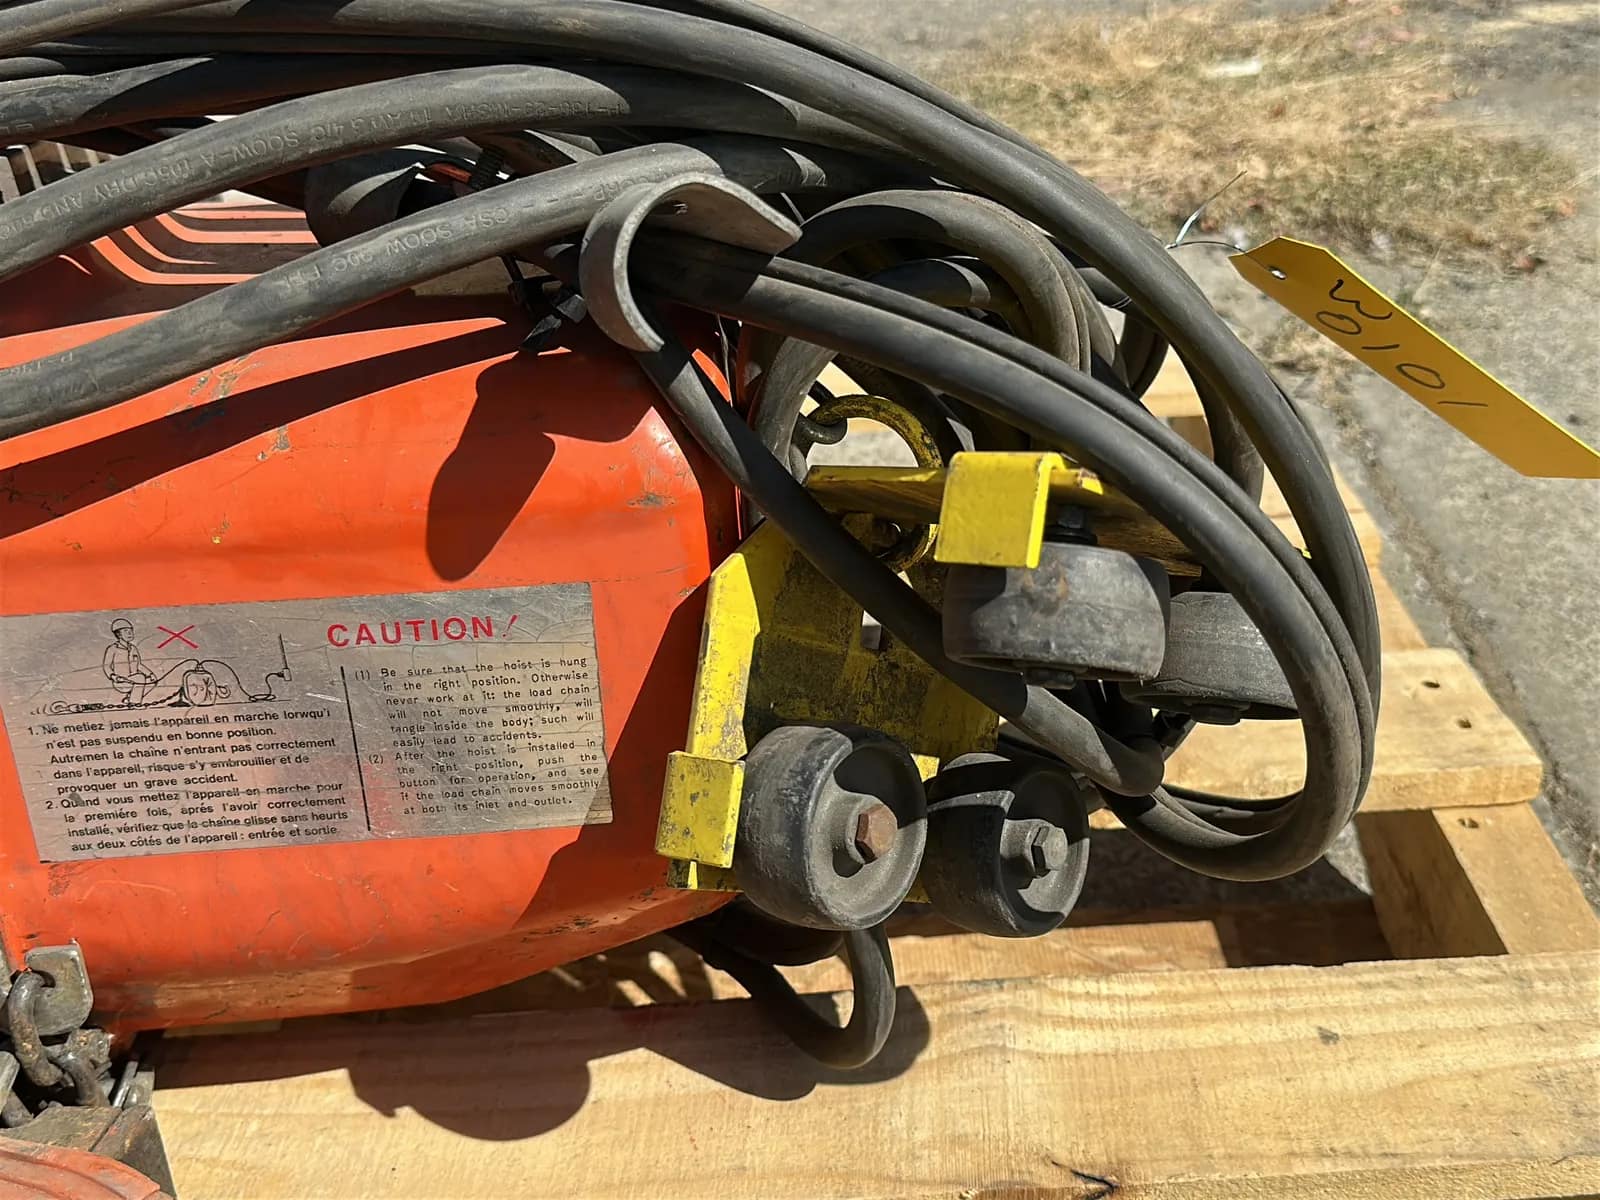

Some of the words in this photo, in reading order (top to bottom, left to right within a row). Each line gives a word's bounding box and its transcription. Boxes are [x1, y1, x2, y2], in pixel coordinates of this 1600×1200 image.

[381, 218, 455, 258] SOOW
[355, 670, 370, 680] (1)
[381, 668, 396, 677] Be
[408, 668, 432, 676] sure
[442, 665, 466, 673] that
[475, 664, 493, 672] the
[504, 660, 533, 670] hoist
[541, 659, 550, 667] is
[560, 658, 587, 667] hung
[384, 682, 392, 691] in
[404, 682, 421, 690] the
[434, 679, 460, 690] right
[471, 675, 521, 688] position.
[531, 670, 588, 683] Otherwise
[386, 696, 418, 705] never
[427, 694, 454, 703] work
[504, 690, 520, 698] the
[530, 688, 552, 696] load
[560, 684, 590, 695] chain
[388, 710, 406, 719] will
[459, 706, 487, 715] move
[505, 702, 560, 713] smoothly,
[575, 698, 592, 707] will
[28, 727, 39, 736] 1.
[42, 725, 59, 735] Ne
[110, 718, 150, 731] jamais
[154, 714, 209, 728] l'appareil
[215, 715, 229, 723] en
[234, 712, 279, 722] marche
[391, 725, 425, 735] tangle
[434, 720, 467, 731] inside
[476, 720, 493, 728] the
[541, 715, 567, 724] such
[577, 712, 593, 721] will
[46, 739, 75, 749] n'est
[80, 737, 101, 748] pas
[105, 731, 162, 744] suspendu
[167, 732, 182, 740] en
[186, 730, 223, 739] bonne
[228, 727, 277, 739] position.
[393, 736, 425, 748] easily
[433, 736, 456, 745] lead
[464, 735, 475, 743] to
[483, 731, 541, 741] accidents.
[50, 752, 109, 764] Autremen
[113, 750, 124, 759] la
[129, 747, 169, 758] chaîne
[174, 744, 226, 755] n'entrant
[231, 743, 252, 754] pas
[256, 738, 336, 750] correctement
[368, 754, 383, 764] (2)
[395, 752, 424, 761] After
[437, 750, 455, 758] the
[468, 746, 496, 756] hoist
[507, 744, 516, 754] is
[528, 740, 575, 752] installed
[587, 739, 595, 747] in
[54, 769, 82, 780] dans
[87, 765, 145, 777] l'appareil,
[148, 763, 185, 773] risque
[189, 760, 206, 771] s'y
[280, 756, 291, 764] et
[295, 754, 309, 763] de
[431, 763, 458, 774] right
[475, 759, 523, 771] position,
[538, 756, 564, 767] push
[580, 753, 597, 761] the
[57, 781, 117, 795] provoquer
[124, 781, 138, 789] un
[145, 778, 177, 789] grave
[183, 773, 238, 784] accident.
[400, 778, 436, 788] button
[450, 776, 465, 785] for
[479, 771, 535, 783] operation,
[548, 769, 567, 777] and
[580, 767, 599, 775] see
[46, 800, 58, 810] 2.
[61, 797, 100, 809] Quand
[106, 795, 134, 805] vous
[140, 792, 179, 803] mettez
[185, 788, 239, 800] l'appareil
[246, 788, 259, 796] en
[266, 784, 310, 795] marche
[316, 783, 343, 793] pour
[416, 791, 434, 800] the
[442, 789, 464, 798] load
[472, 787, 501, 797] chain
[510, 785, 544, 794] moves
[552, 780, 599, 791] smoothly
[64, 814, 75, 823] la
[147, 807, 172, 817] fois,
[222, 802, 258, 812] l'avoir
[267, 797, 346, 809] correctement
[404, 807, 415, 815] at
[422, 804, 446, 813] both
[455, 802, 468, 811] its
[475, 801, 500, 810] inlet
[508, 799, 527, 808] and
[68, 824, 113, 837] installé,
[117, 821, 159, 833] vérifiez
[163, 821, 184, 831] que
[188, 819, 198, 829] la
[202, 816, 241, 828] chaîne
[244, 813, 281, 826] glisse
[281, 813, 308, 823] sans
[312, 810, 348, 821] heurts
[72, 842, 93, 851] aux
[97, 838, 126, 849] deux
[130, 836, 162, 847] côtés
[166, 836, 181, 845] de
[184, 833, 238, 844] l'appareil
[248, 827, 285, 839] entrée
[289, 827, 300, 837] et
[305, 826, 337, 837] sortie
